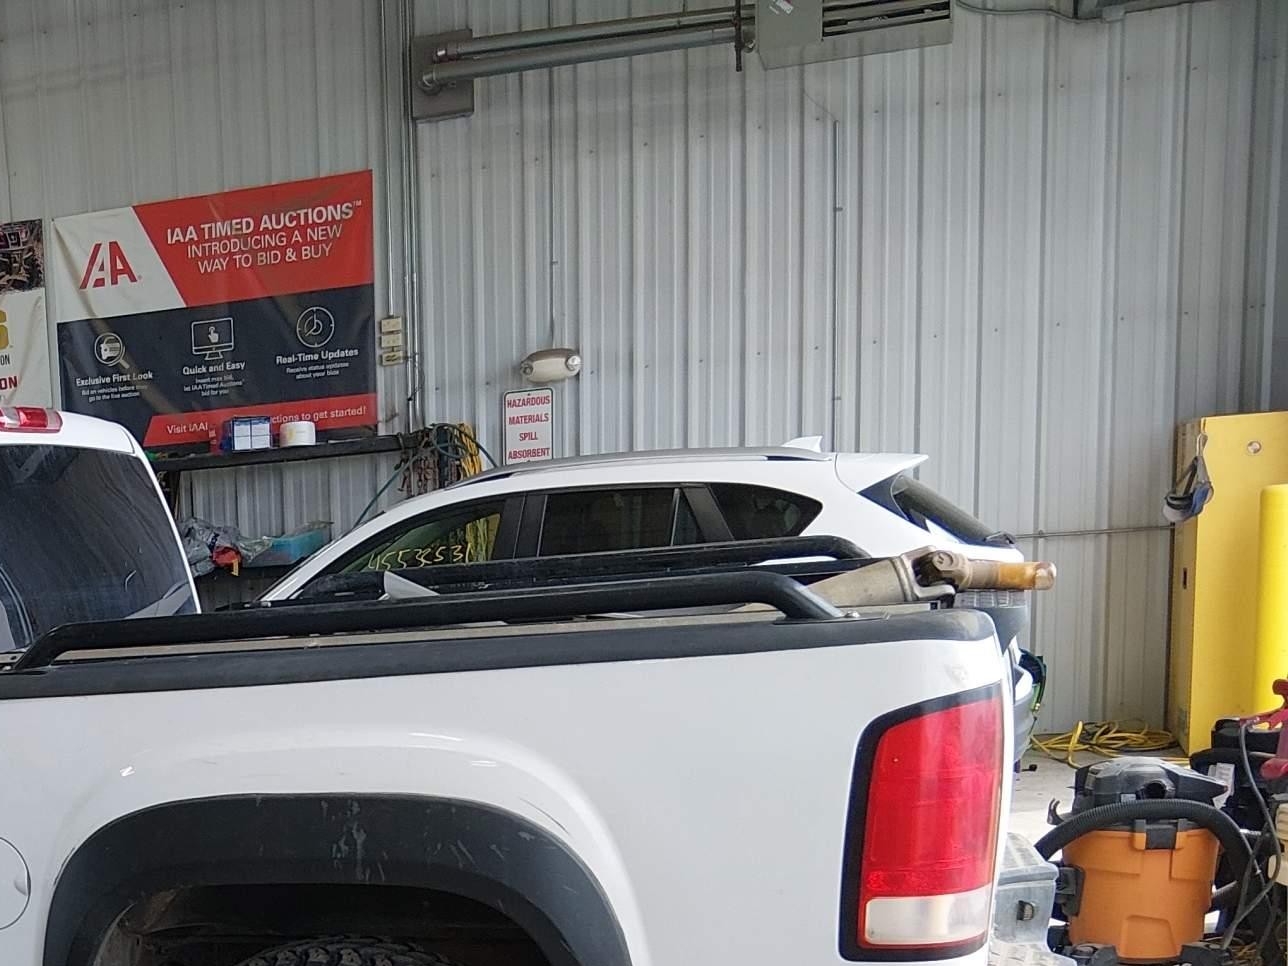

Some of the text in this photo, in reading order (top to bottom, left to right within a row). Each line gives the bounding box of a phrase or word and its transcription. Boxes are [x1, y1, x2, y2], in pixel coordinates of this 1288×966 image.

[167, 226, 199, 244] IAA
[201, 217, 254, 240] TIMED
[187, 223, 343, 258] INTRODUCING A NEW
[198, 243, 333, 274] WAY TO BID & BUY
[276, 349, 359, 365] Real-Time Updates
[183, 361, 246, 375] Quick and Easy
[76, 375, 111, 386] Exclusive
[112, 373, 130, 382] First
[507, 395, 550, 408] HAZARDOUS
[166, 424, 187, 435] Visit
[301, 411, 311, 421] to
[313, 410, 328, 421] get
[330, 405, 367, 417] started!
[509, 413, 549, 425] MATERIALS
[519, 432, 538, 442] SPILL
[508, 448, 550, 460] ABSORBENT
